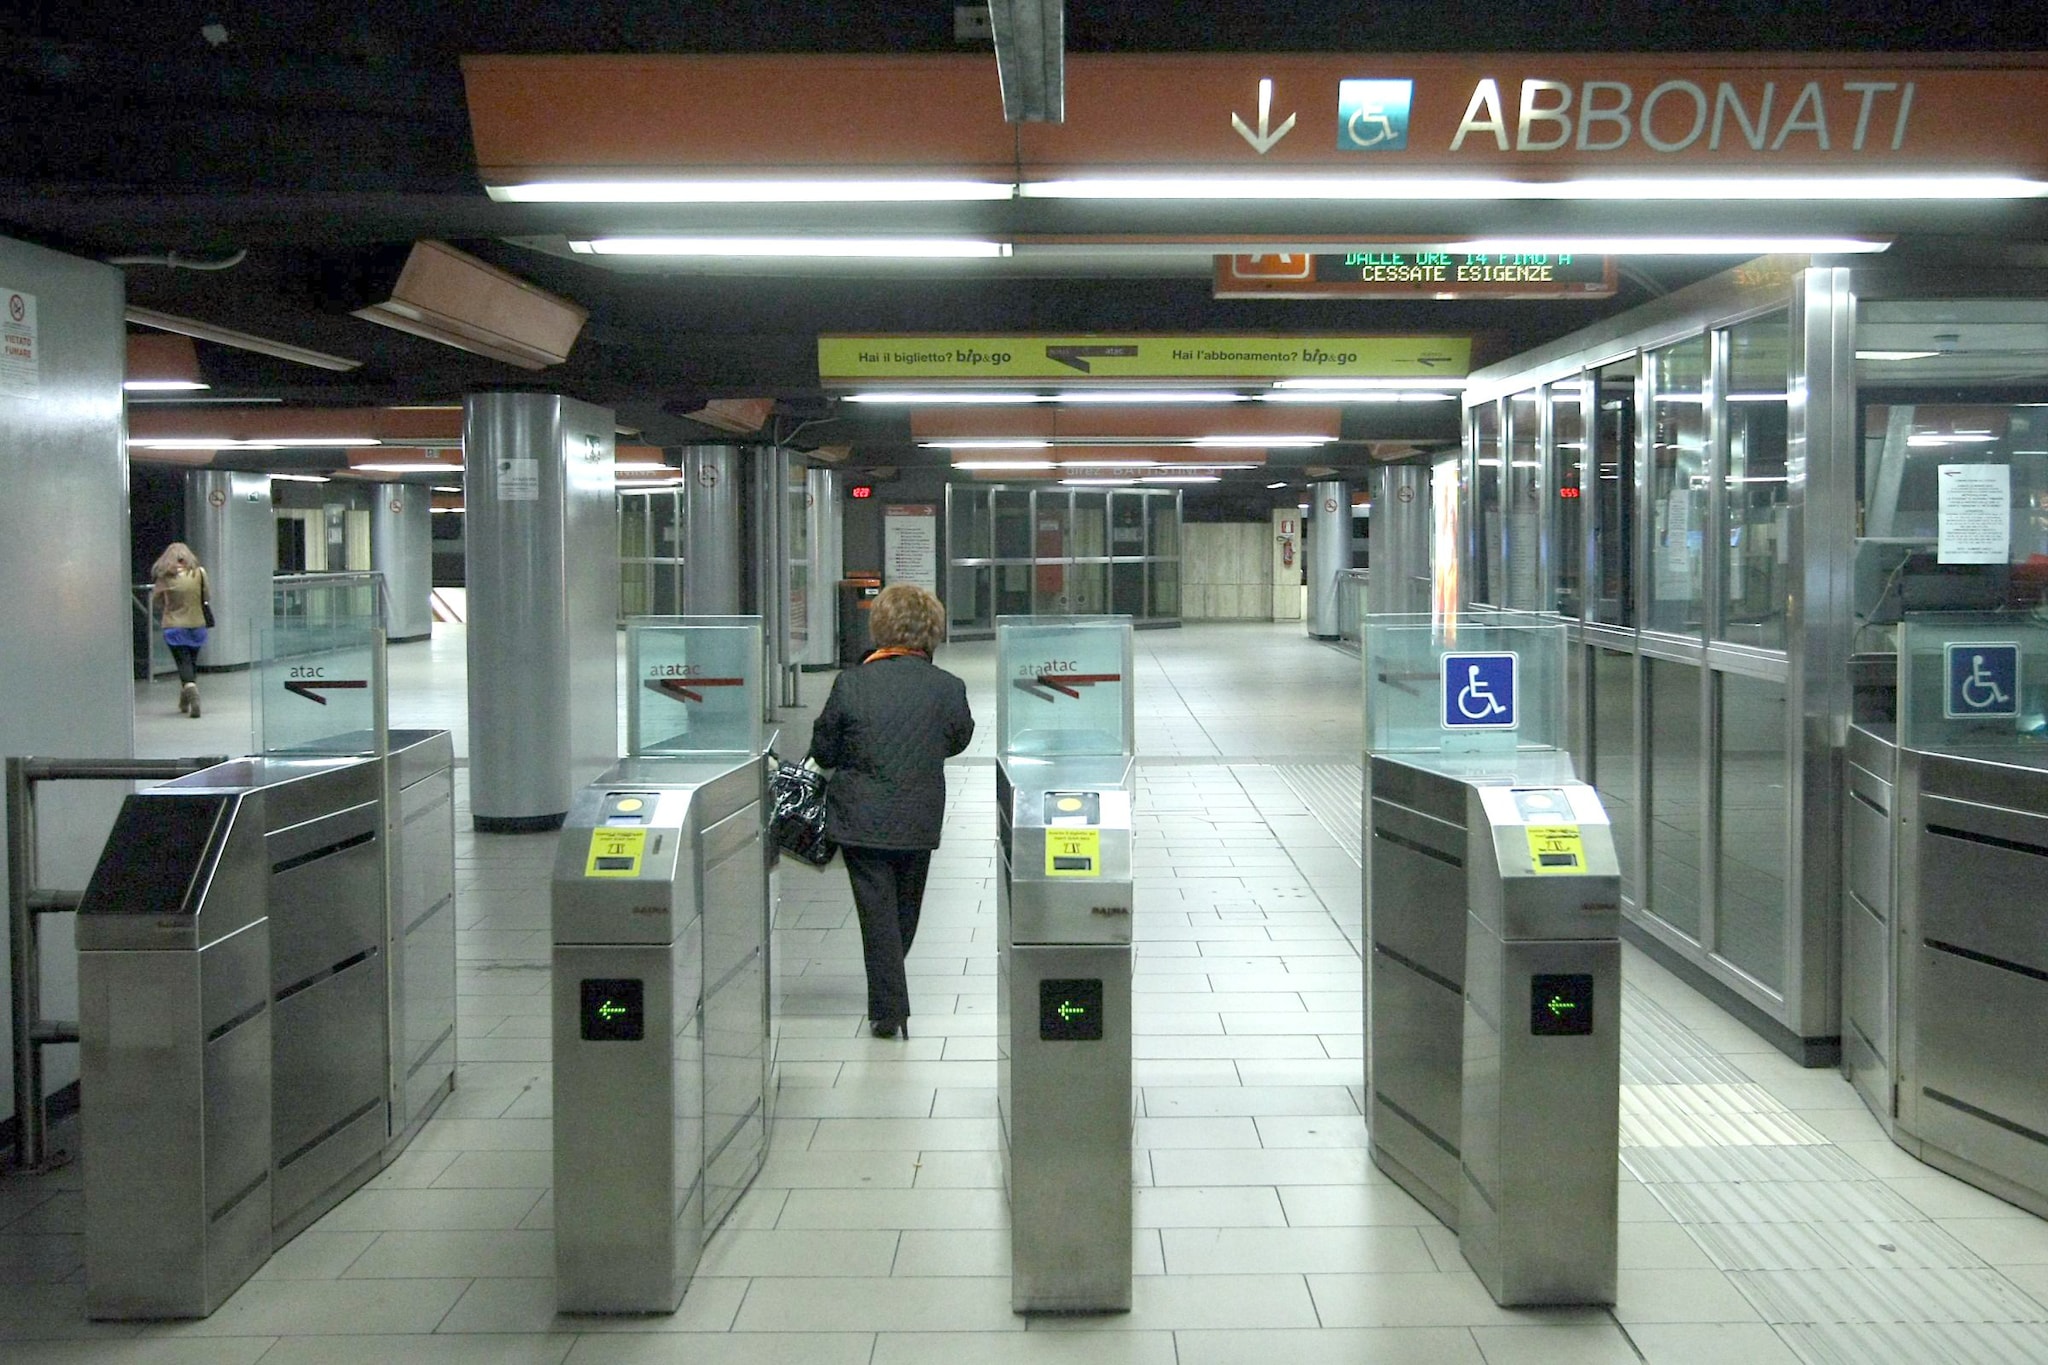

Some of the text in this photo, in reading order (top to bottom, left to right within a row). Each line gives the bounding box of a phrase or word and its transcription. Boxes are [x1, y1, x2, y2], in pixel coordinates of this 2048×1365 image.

[1448, 78, 1915, 152] ABBONATI
[1363, 266, 1553, 282] CESSATE ESIGENZE
[858, 352, 880, 363] Hai
[884, 352, 891, 363] il
[894, 351, 952, 366] biglietto?
[1172, 350, 1194, 361] Hai
[1197, 350, 1298, 362] l'abbonamento?
[290, 666, 325, 677] atac
